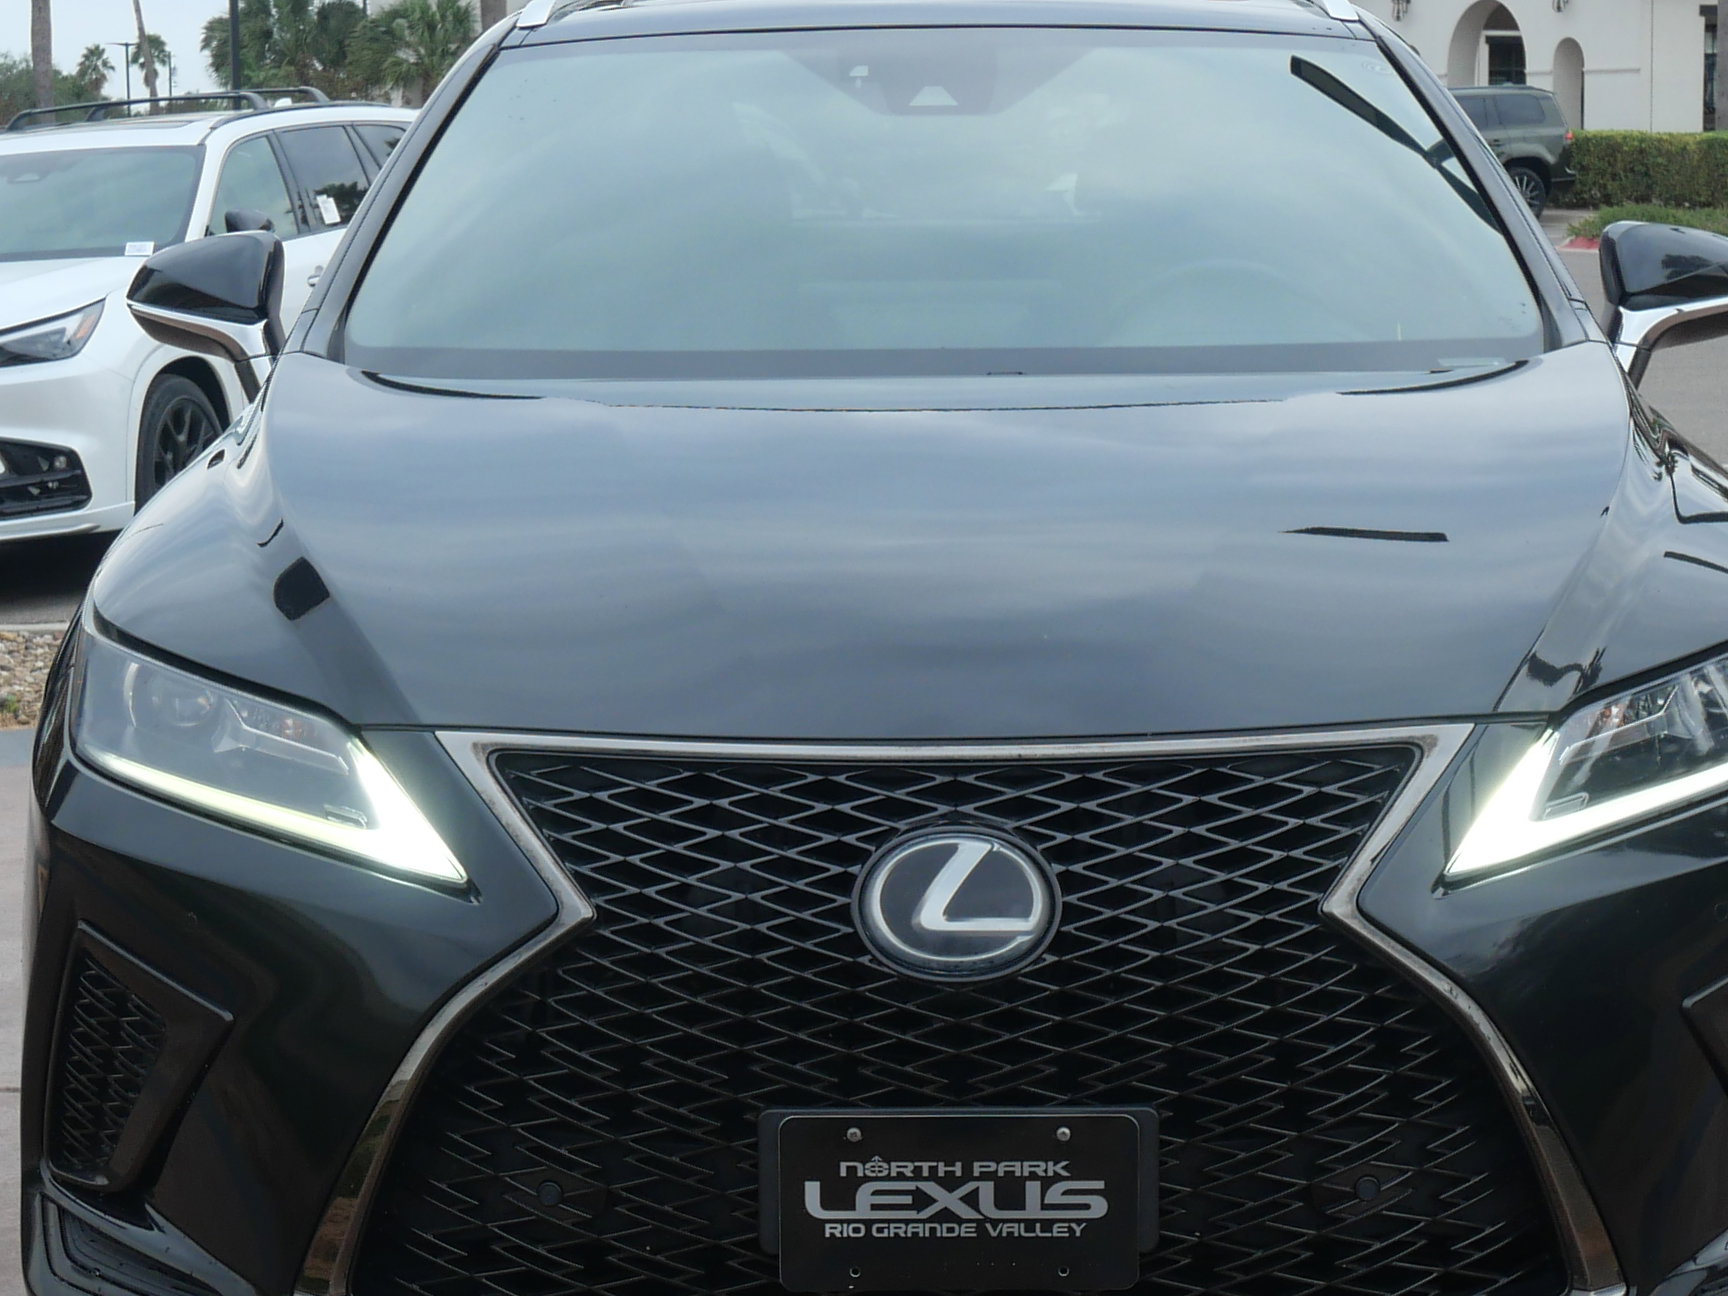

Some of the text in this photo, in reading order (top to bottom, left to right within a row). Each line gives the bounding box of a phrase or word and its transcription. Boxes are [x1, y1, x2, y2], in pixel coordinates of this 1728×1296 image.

[839, 1159, 1072, 1177] NORTH PARK
[803, 1179, 1109, 1220] LEXUS
[824, 1221, 1088, 1238] RIO GRANDE VALLEY
